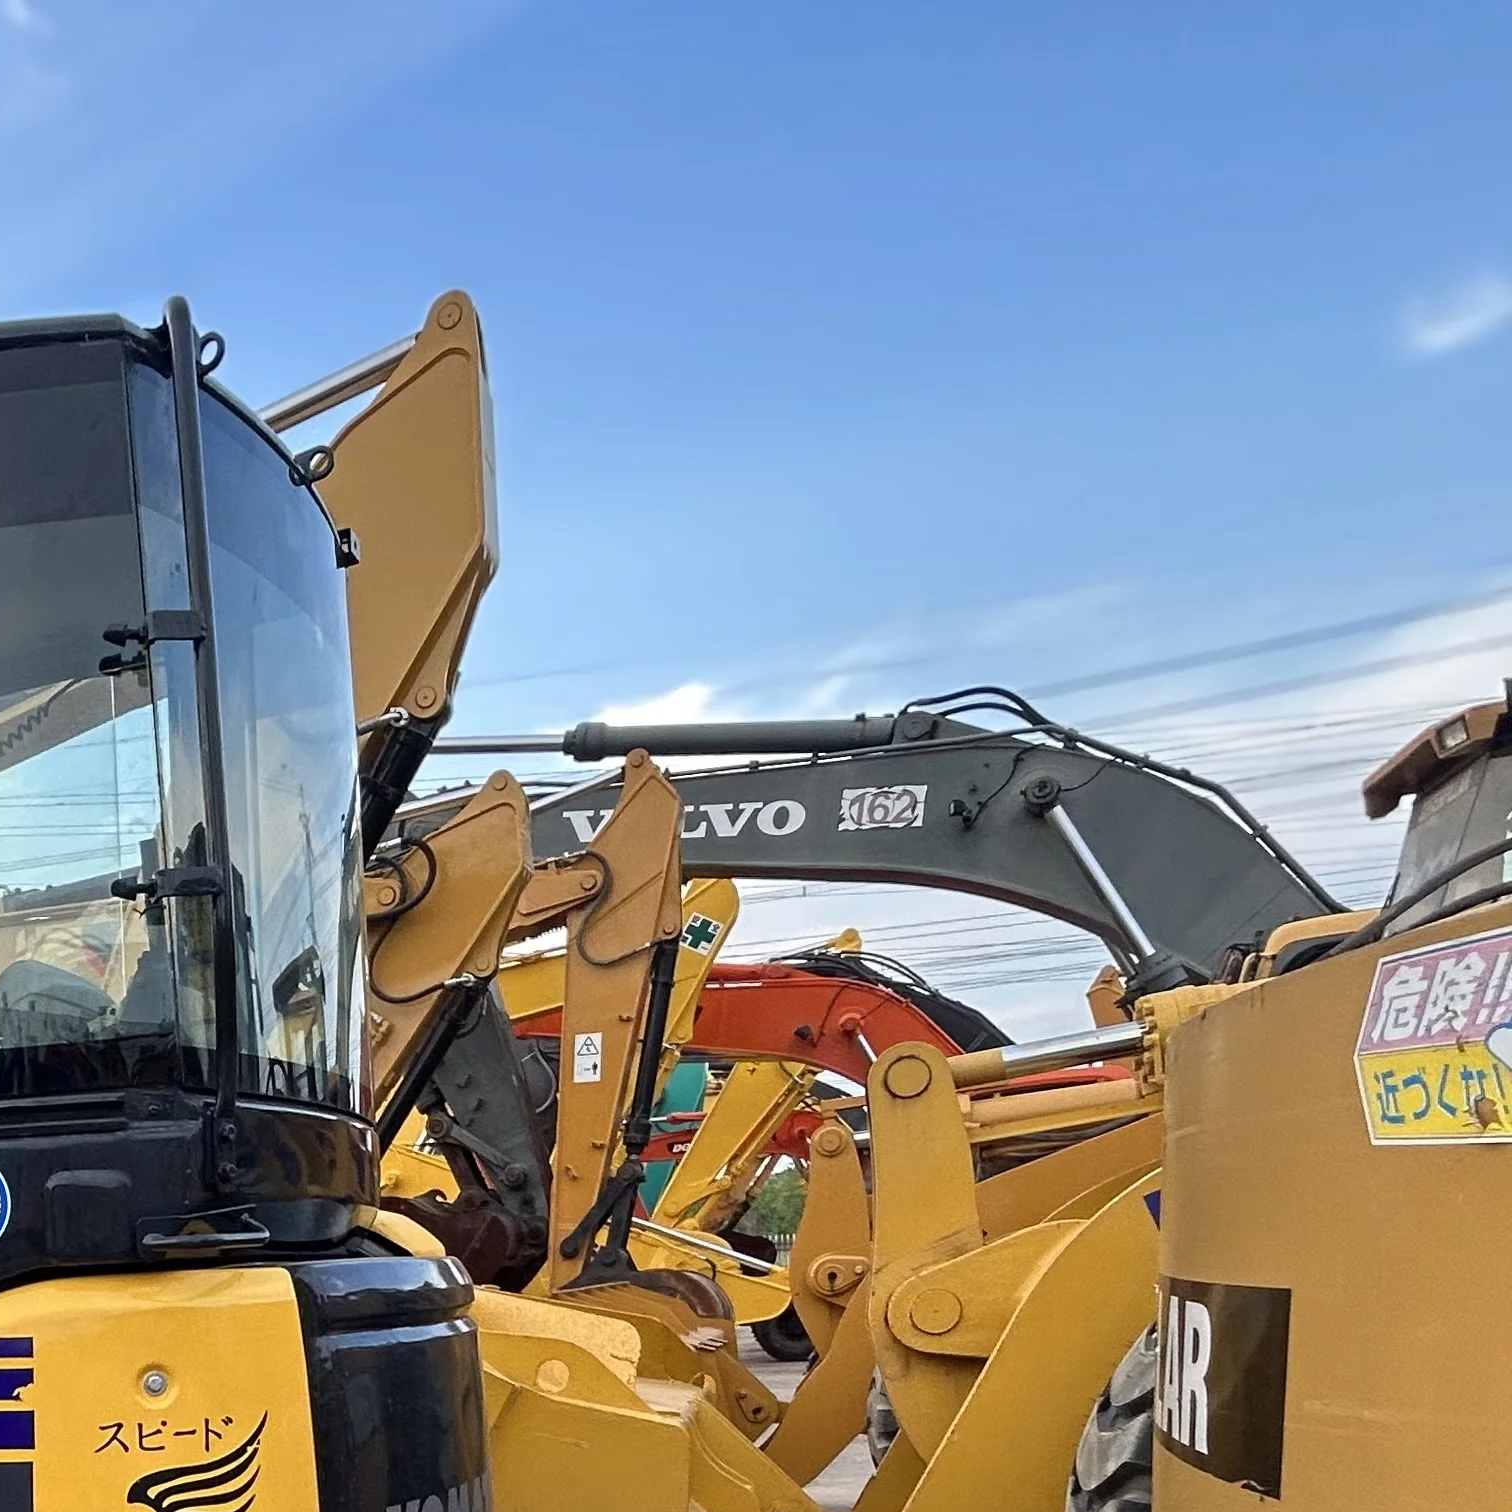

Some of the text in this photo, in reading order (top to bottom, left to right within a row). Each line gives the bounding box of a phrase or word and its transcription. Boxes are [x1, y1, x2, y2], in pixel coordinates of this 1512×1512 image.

[562, 799, 806, 843] VLVO
[849, 788, 917, 826] 162
[94, 1416, 233, 1453] スピード
